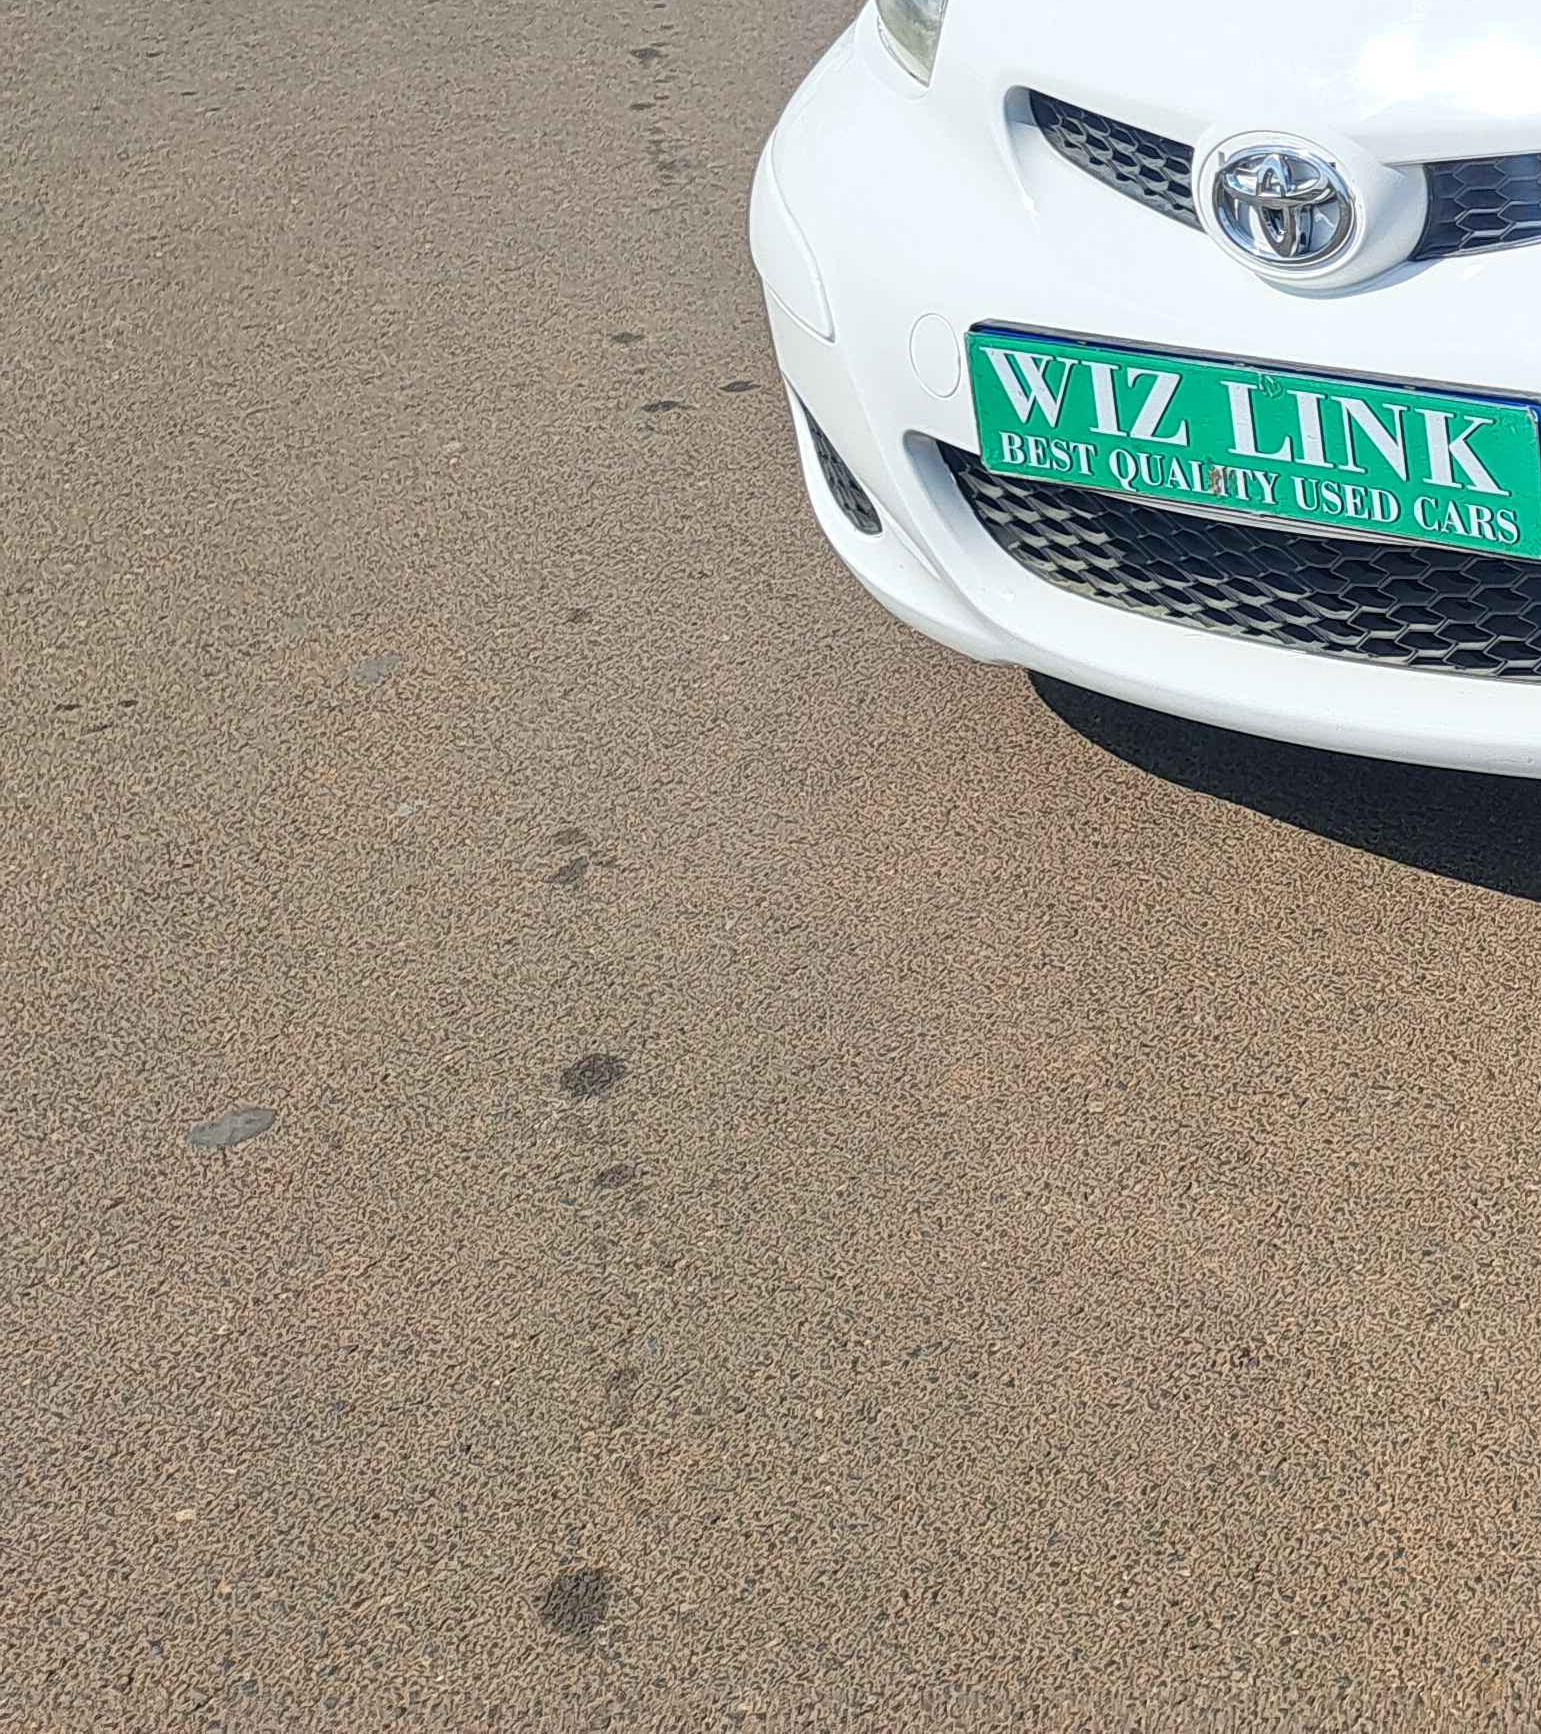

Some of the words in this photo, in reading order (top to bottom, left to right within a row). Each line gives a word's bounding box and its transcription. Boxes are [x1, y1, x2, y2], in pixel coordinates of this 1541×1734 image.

[979, 345, 1189, 447] WIZ
[1220, 379, 1510, 496] LINK
[998, 429, 1098, 475] BEST
[1108, 447, 1282, 506] QUALITY
[1292, 475, 1400, 524] USED
[1412, 496, 1520, 546] CARS
